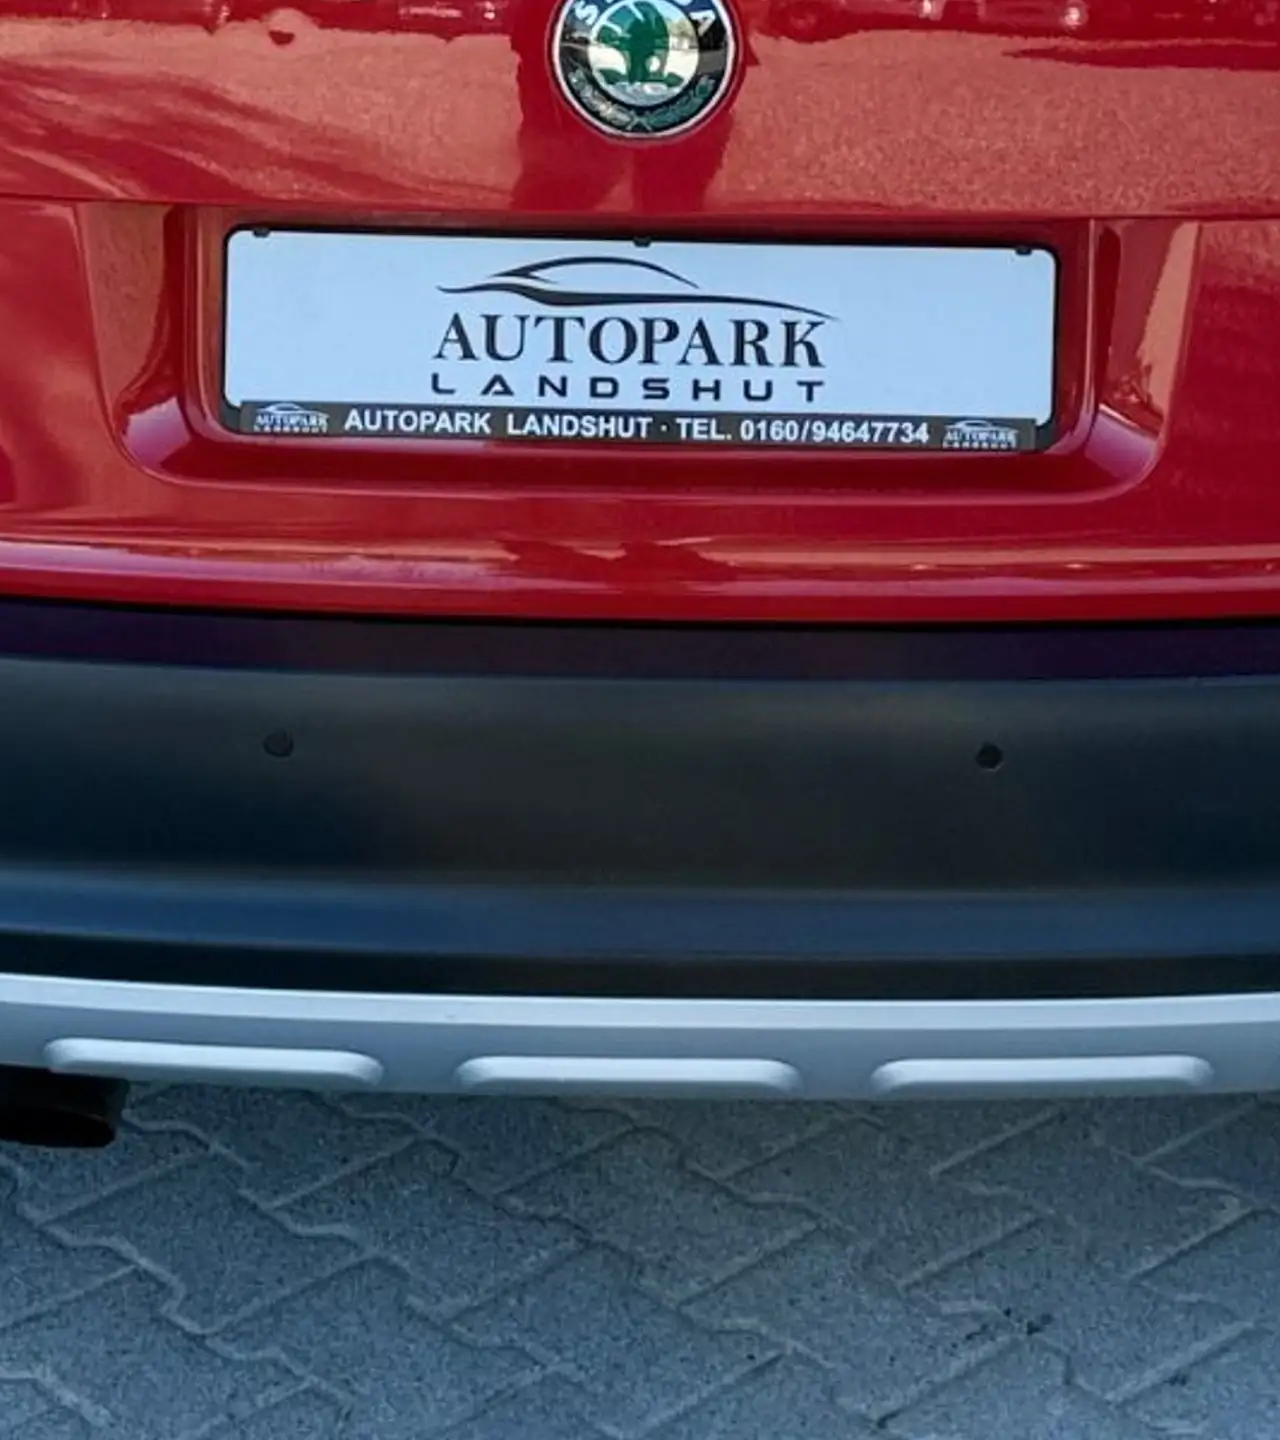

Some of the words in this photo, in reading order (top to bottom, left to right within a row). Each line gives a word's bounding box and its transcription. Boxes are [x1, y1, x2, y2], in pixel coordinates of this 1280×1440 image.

[432, 312, 826, 368] AUTOPARK
[431, 373, 824, 403] LANDSHUT
[344, 409, 492, 434] AUTOPARK
[507, 413, 653, 439] LANDSHUT
[676, 418, 732, 440] TEL.
[740, 419, 930, 443] 0160/94647734
